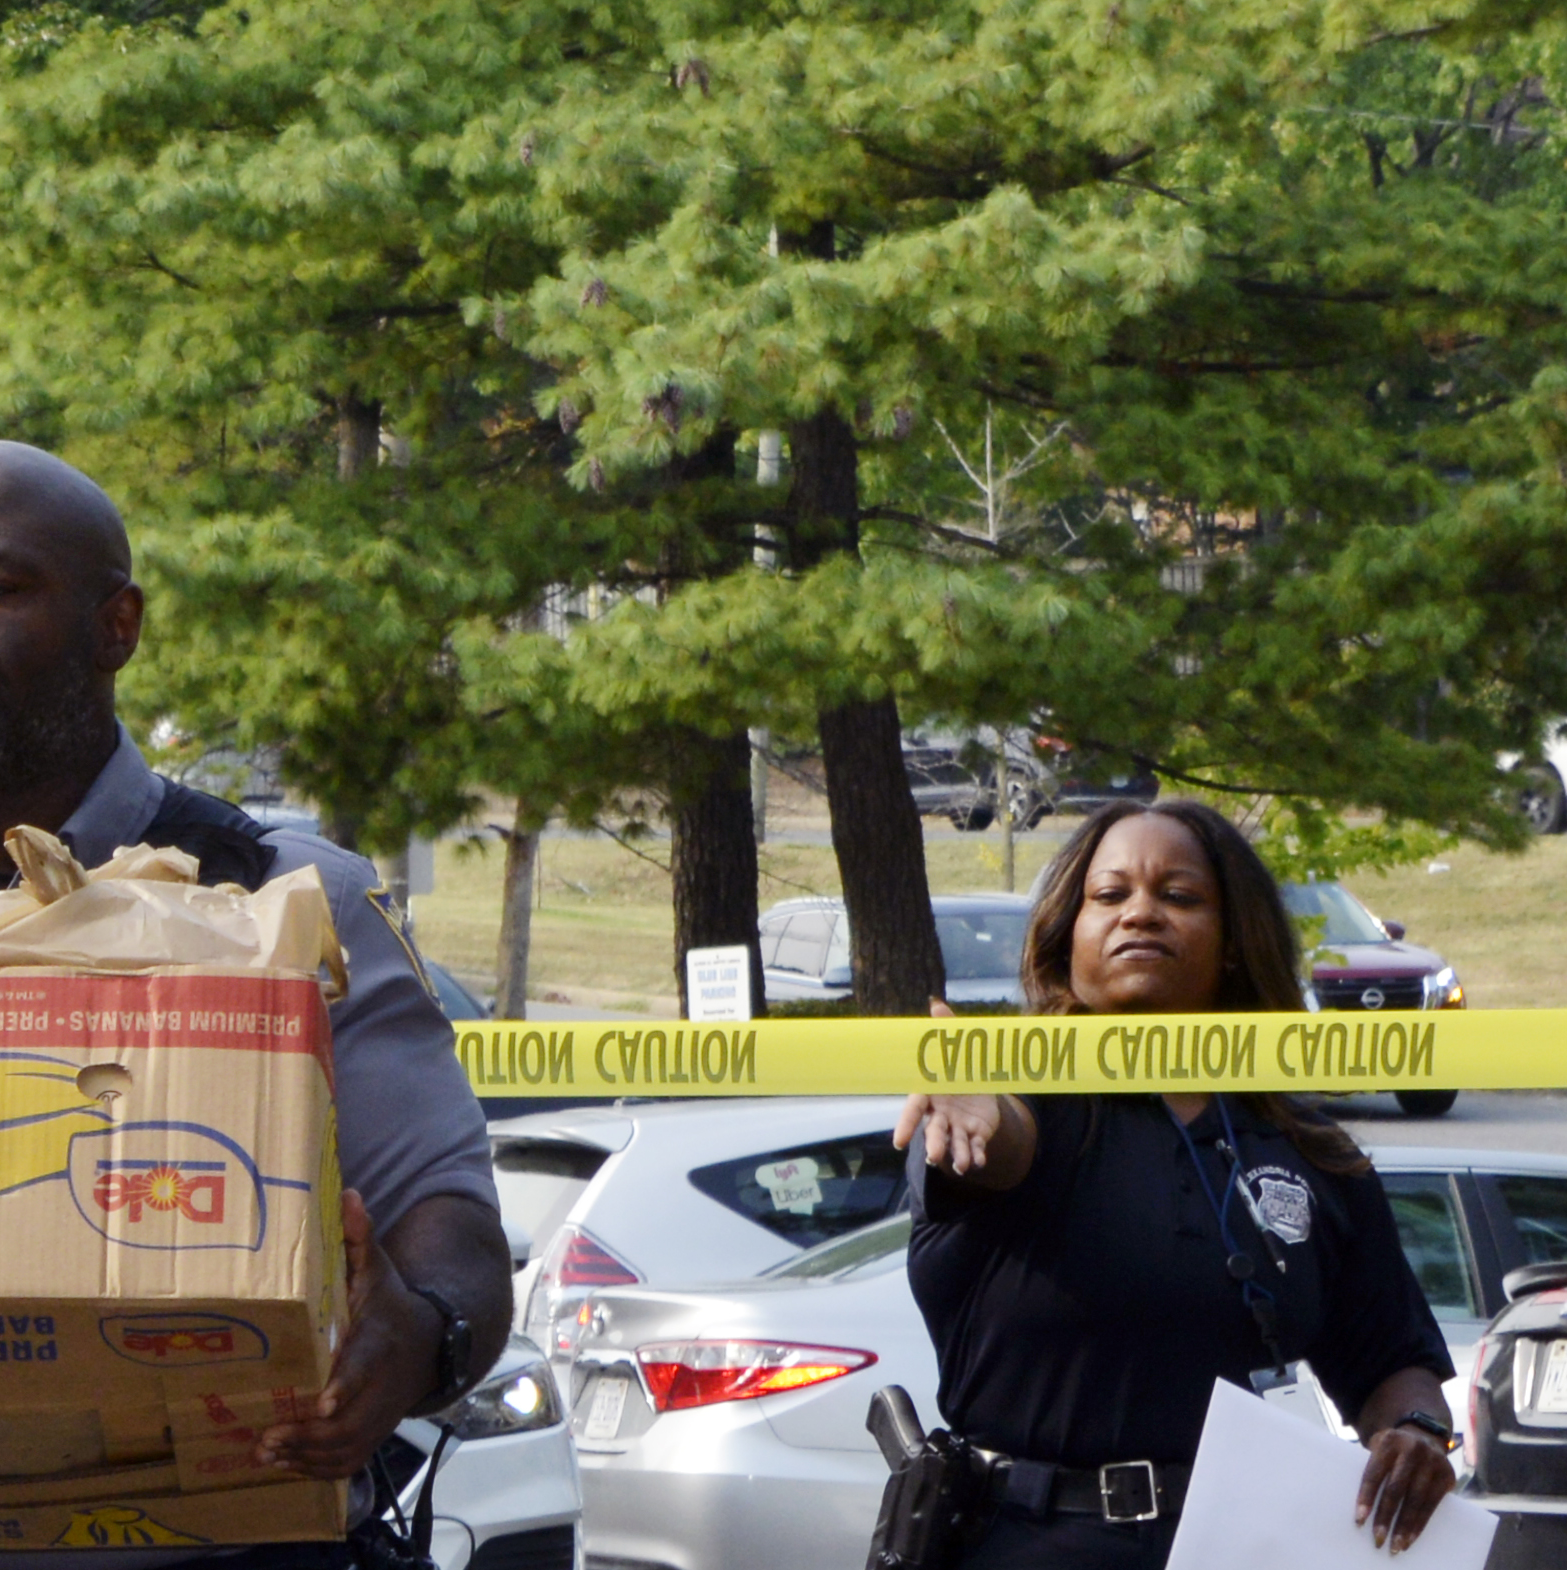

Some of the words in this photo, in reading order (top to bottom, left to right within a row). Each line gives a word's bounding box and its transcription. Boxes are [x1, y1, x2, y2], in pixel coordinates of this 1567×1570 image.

[69, 1010, 181, 1031] BANANAS
[190, 1010, 301, 1037] PREMIUM
[773, 1162, 800, 1181] lyft
[92, 1167, 226, 1224] Dole
[775, 1187, 814, 1203] Uber
[123, 1330, 235, 1358] Dole
